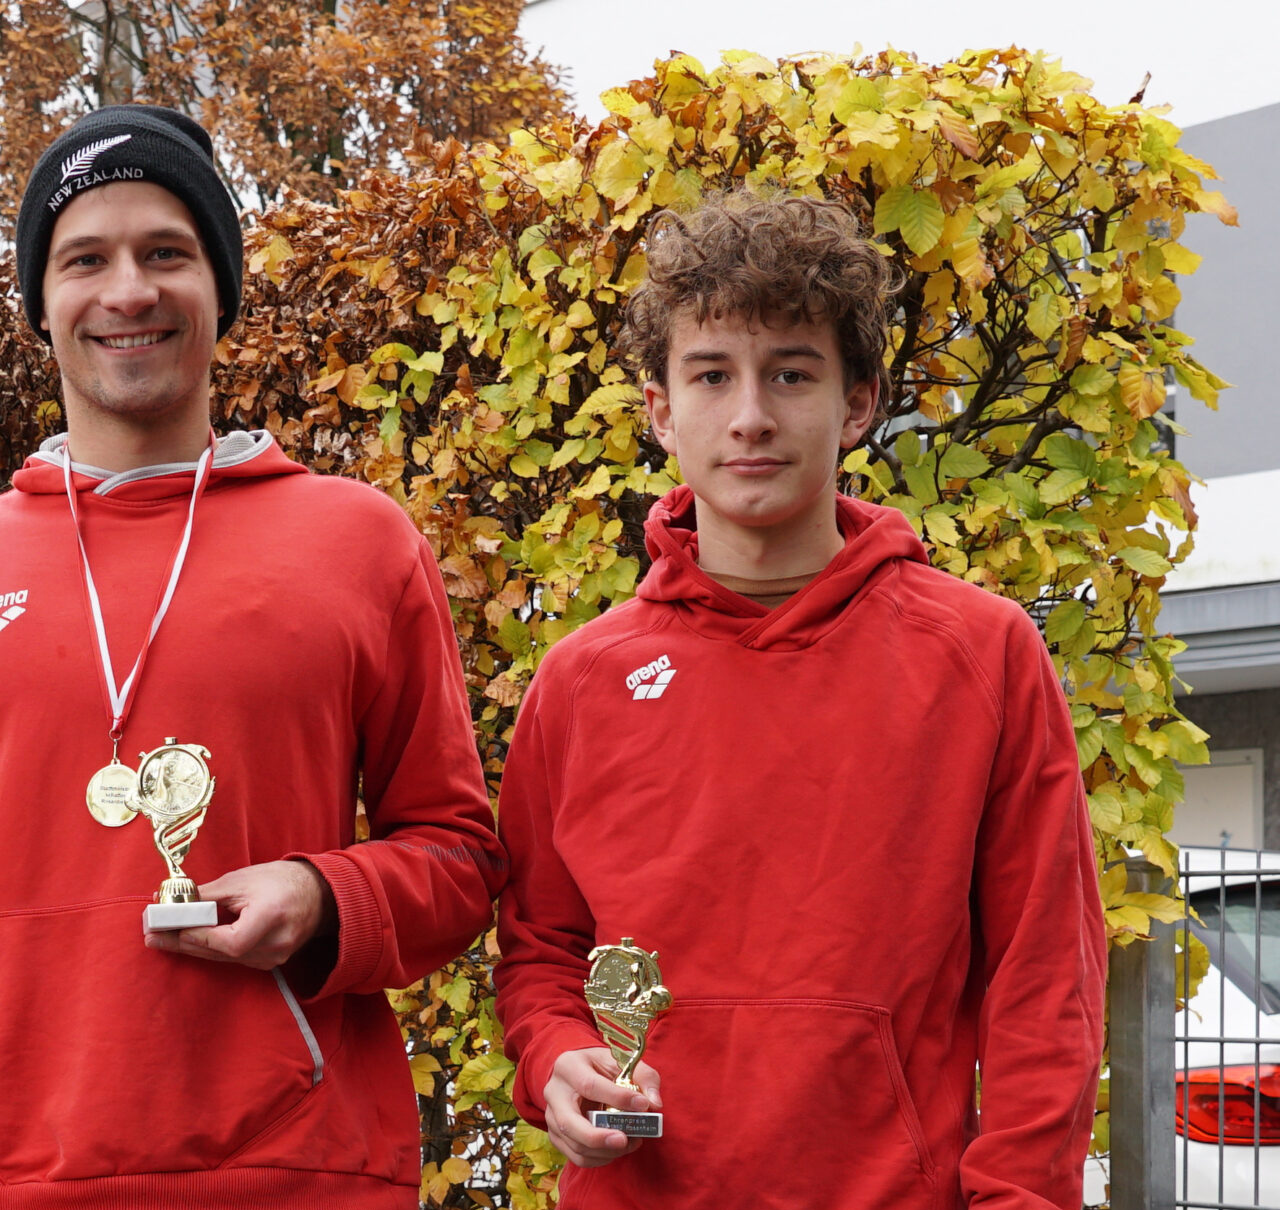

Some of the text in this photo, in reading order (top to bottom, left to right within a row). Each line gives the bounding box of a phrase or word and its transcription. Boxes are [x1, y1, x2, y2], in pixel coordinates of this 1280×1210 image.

[47, 166, 144, 212] NEW ZEALAND
[625, 654, 672, 691] arena
